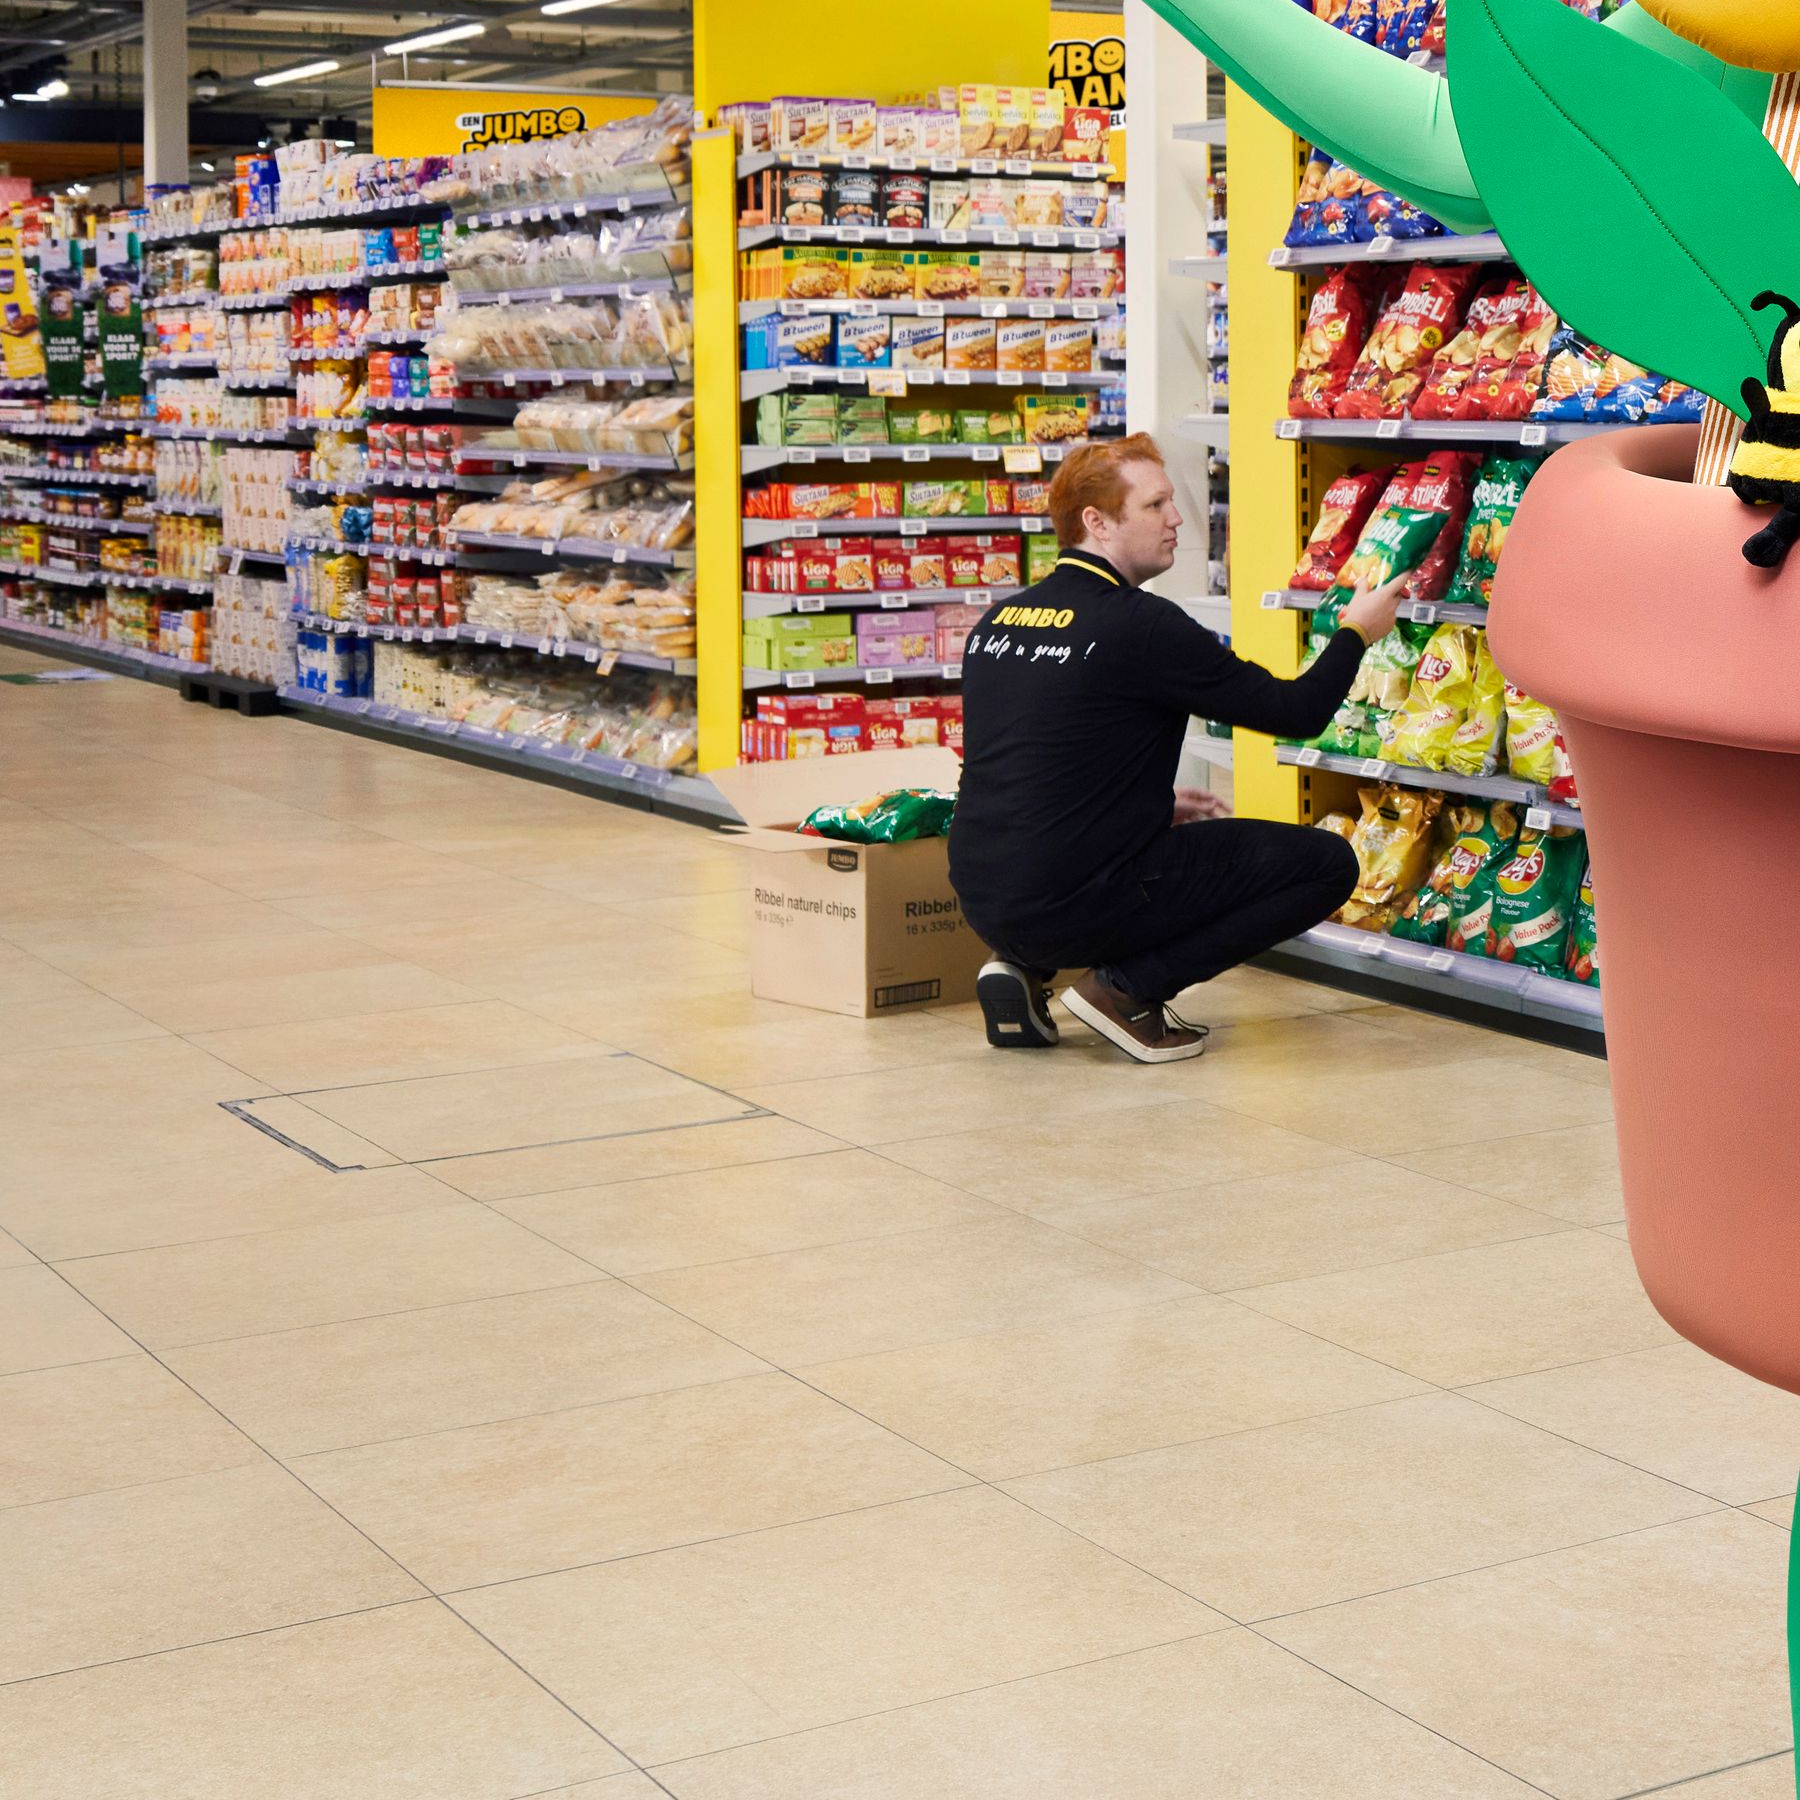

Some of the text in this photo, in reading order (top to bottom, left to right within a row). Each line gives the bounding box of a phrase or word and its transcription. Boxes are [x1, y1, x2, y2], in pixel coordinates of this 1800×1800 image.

[788, 104, 822, 119] SULTANA
[835, 106, 870, 120] SULTANA
[462, 116, 480, 127] EEN
[474, 108, 581, 142] JUMBO
[794, 488, 829, 504] SULTANA
[909, 486, 942, 503] SULTANA
[991, 607, 1074, 628] JUMBO
[984, 634, 1011, 659] help
[1015, 644, 1025, 656] u
[1030, 645, 1071, 664] graag
[1084, 641, 1096, 660] !
[754, 888, 857, 919] Ribbel naturel chips
[905, 898, 958, 918] Ribbel
[1496, 896, 1530, 909] Bolognese
[906, 920, 956, 935] 16 x 335g
[1514, 913, 1560, 941] Value Pack
